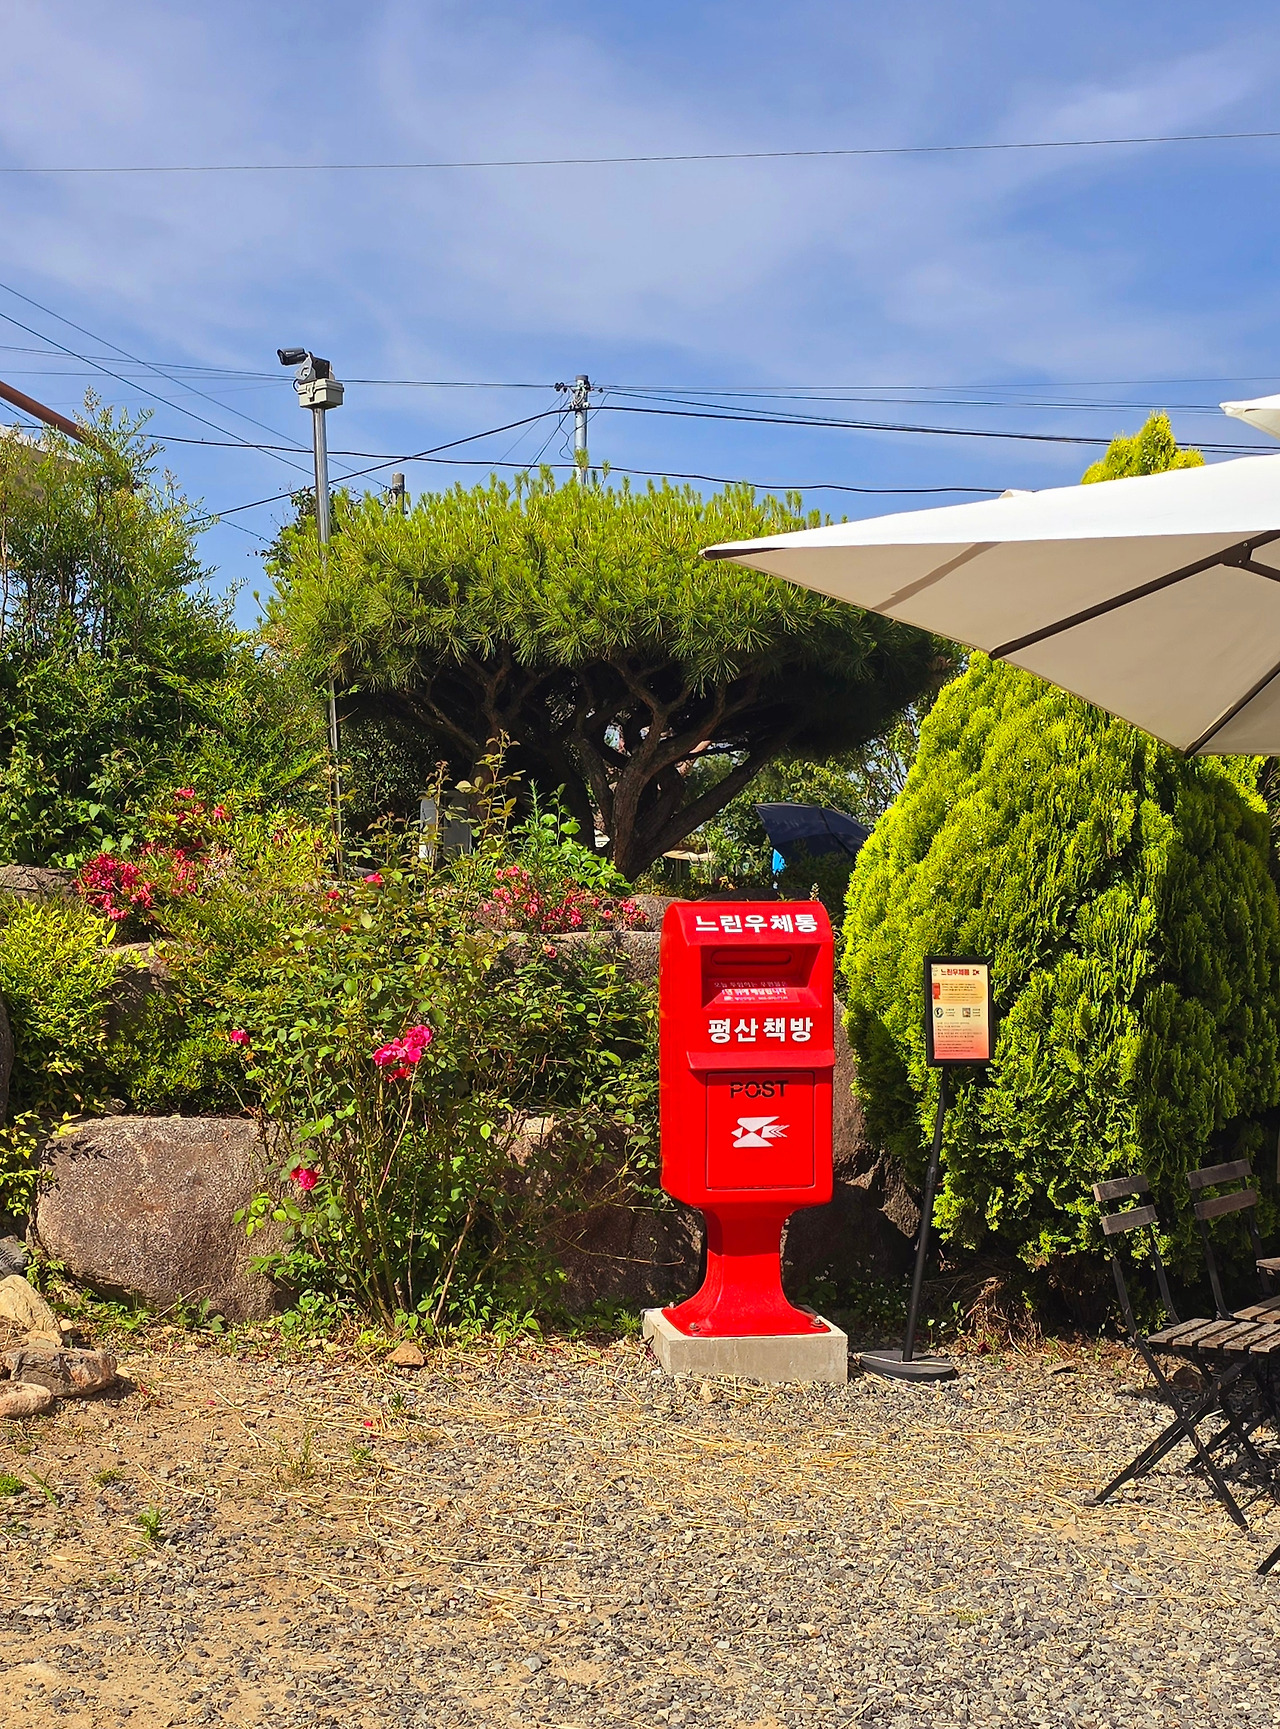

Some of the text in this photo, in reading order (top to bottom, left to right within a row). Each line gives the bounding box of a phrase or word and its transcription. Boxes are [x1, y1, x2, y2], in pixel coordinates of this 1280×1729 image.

[695, 914, 818, 933] 느린우체통
[708, 1017, 813, 1044] 평산책방
[730, 1080, 789, 1099] POST
